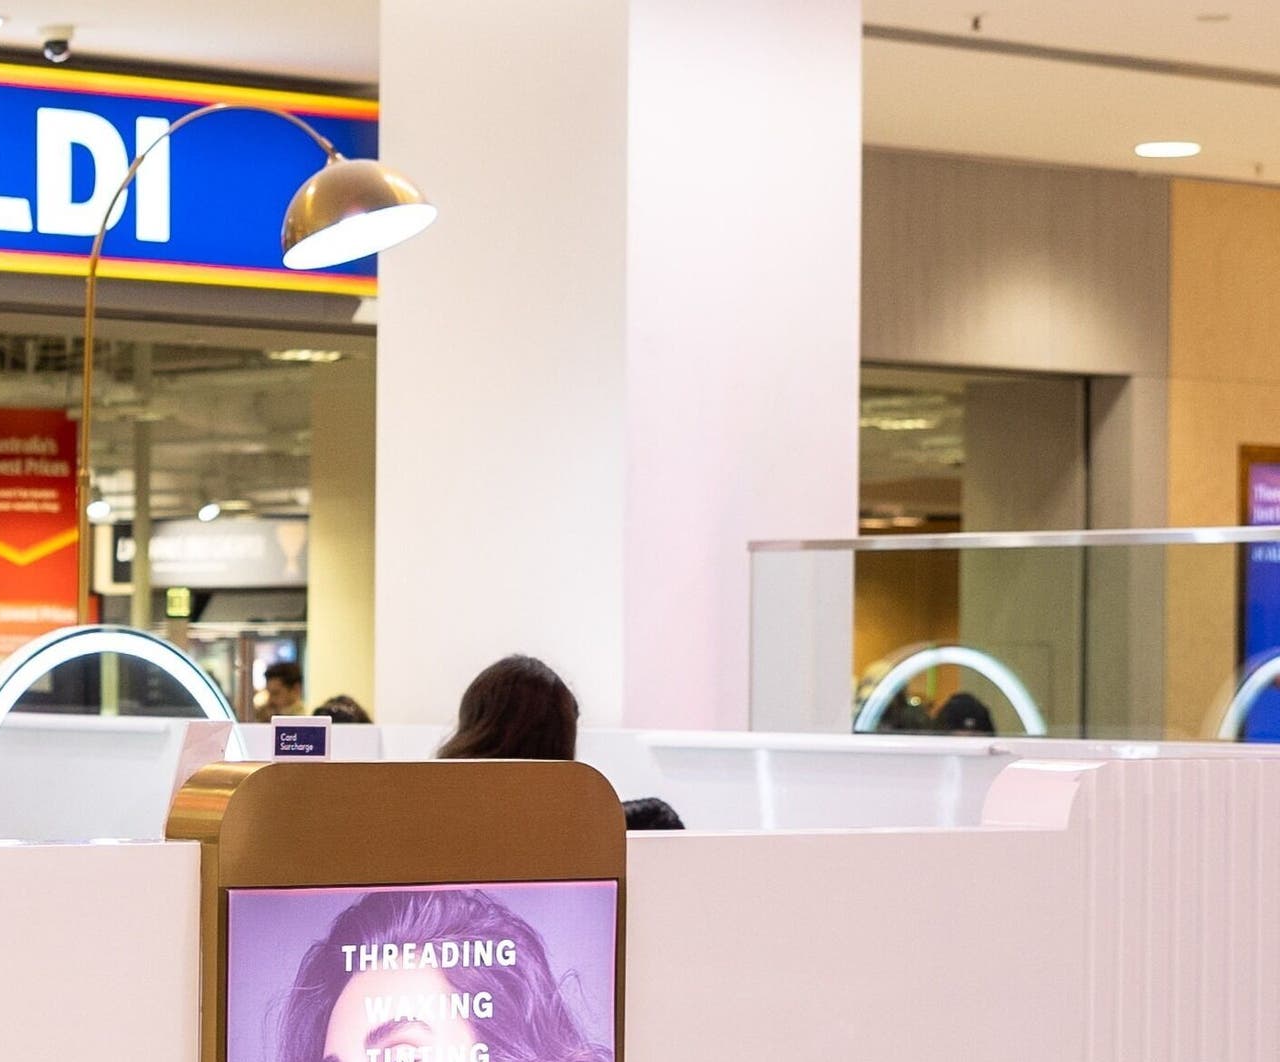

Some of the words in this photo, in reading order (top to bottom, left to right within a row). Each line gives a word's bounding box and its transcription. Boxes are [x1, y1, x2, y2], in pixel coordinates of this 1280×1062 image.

[280, 732, 297, 742] Card
[280, 742, 314, 754] Surcharge
[342, 939, 517, 972] THREADING
[365, 992, 494, 1024] WAXING
